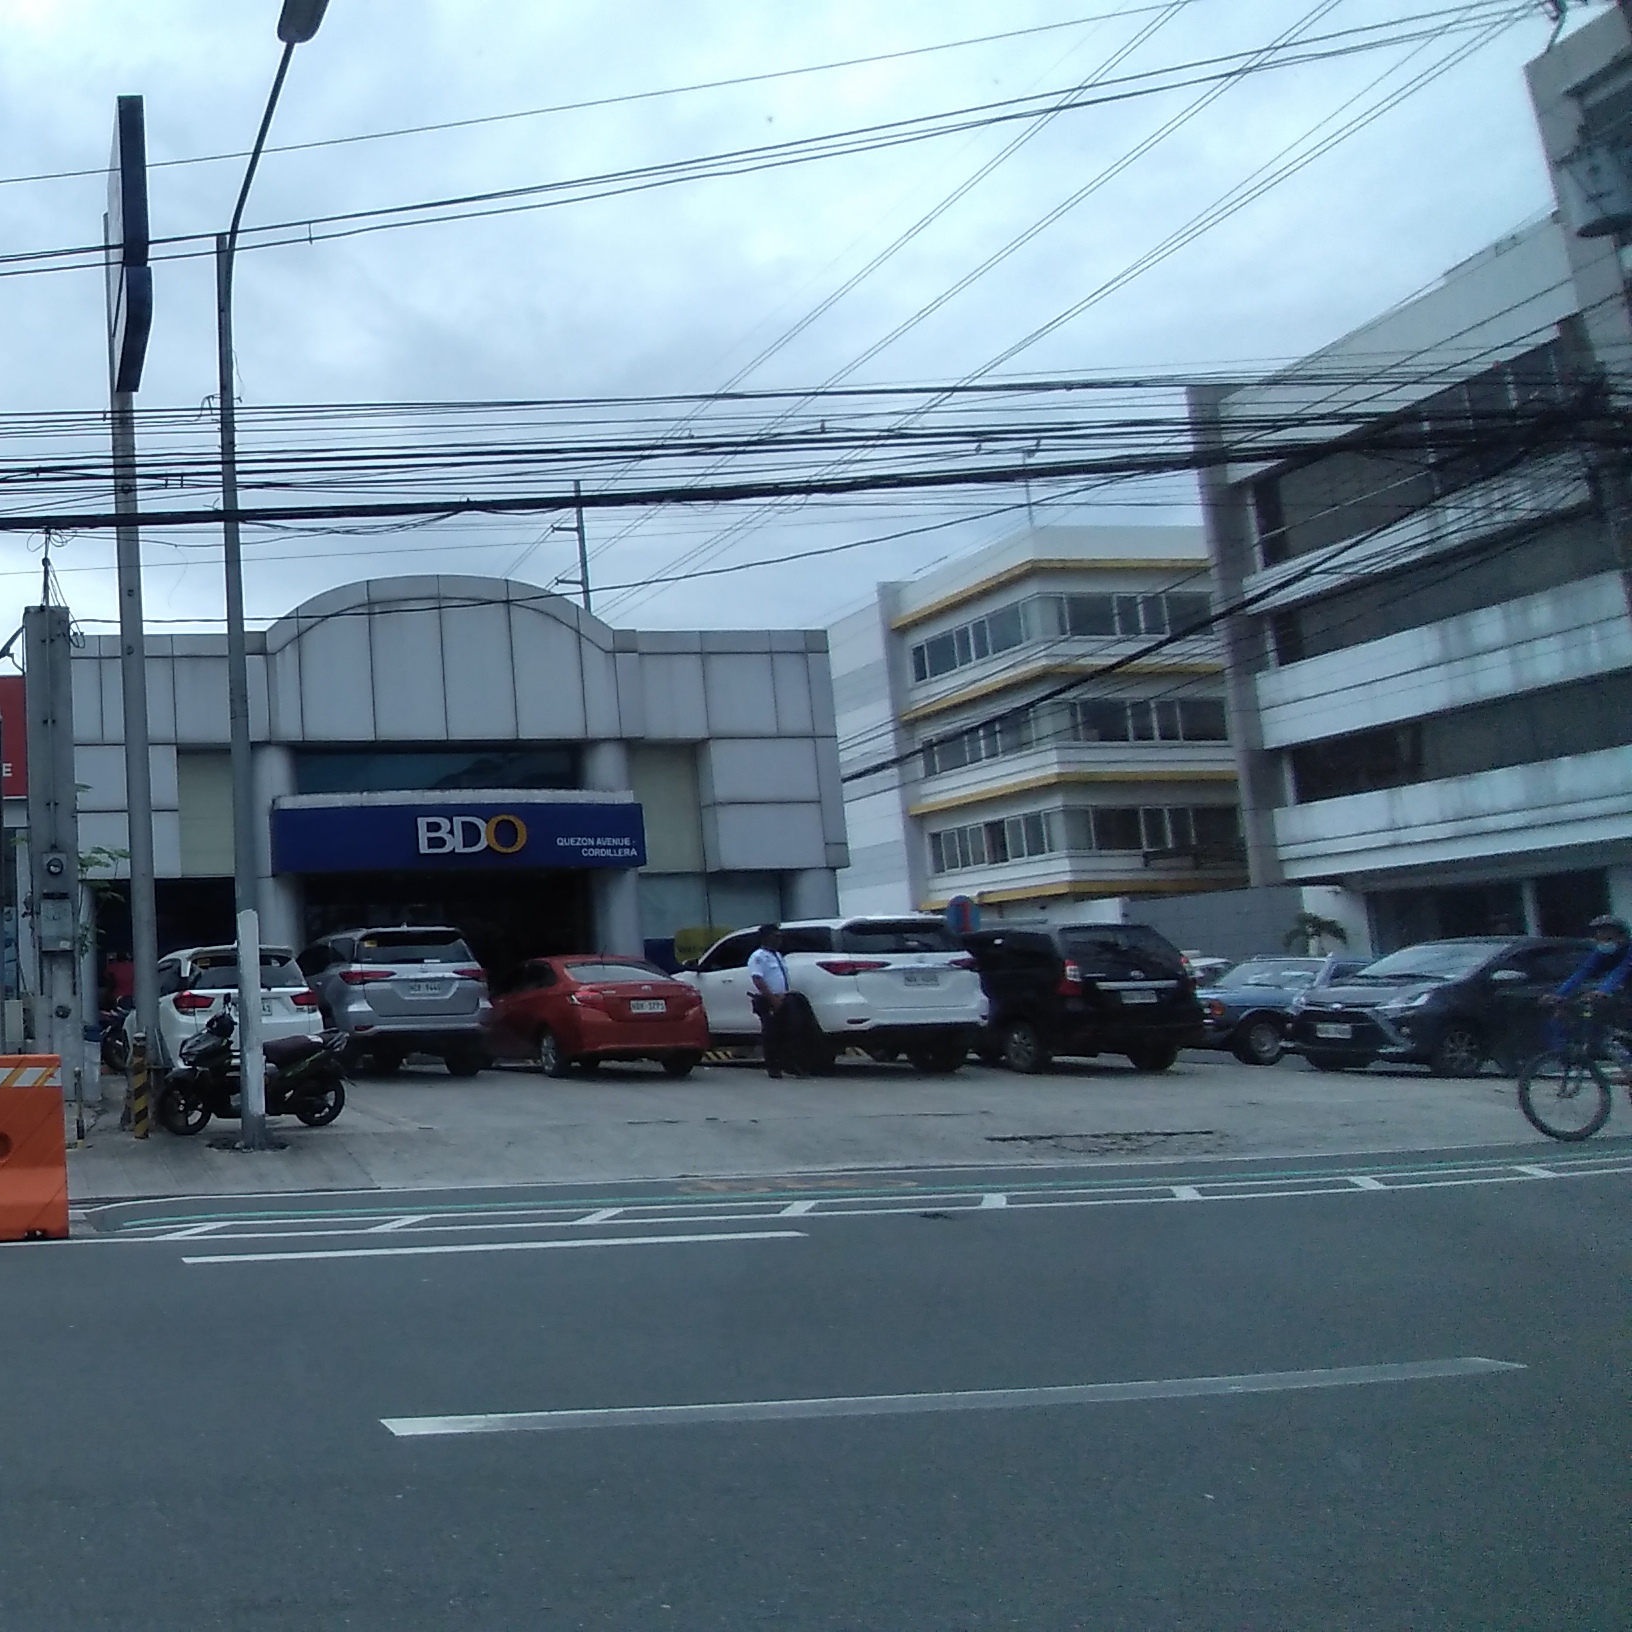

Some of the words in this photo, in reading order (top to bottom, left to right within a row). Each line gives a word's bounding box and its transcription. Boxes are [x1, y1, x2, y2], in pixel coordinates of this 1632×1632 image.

[416, 814, 528, 854] BDO
[556, 836, 595, 847] QUEZON
[596, 837, 631, 847] AVENUE
[581, 847, 638, 858] CORDILLERA
